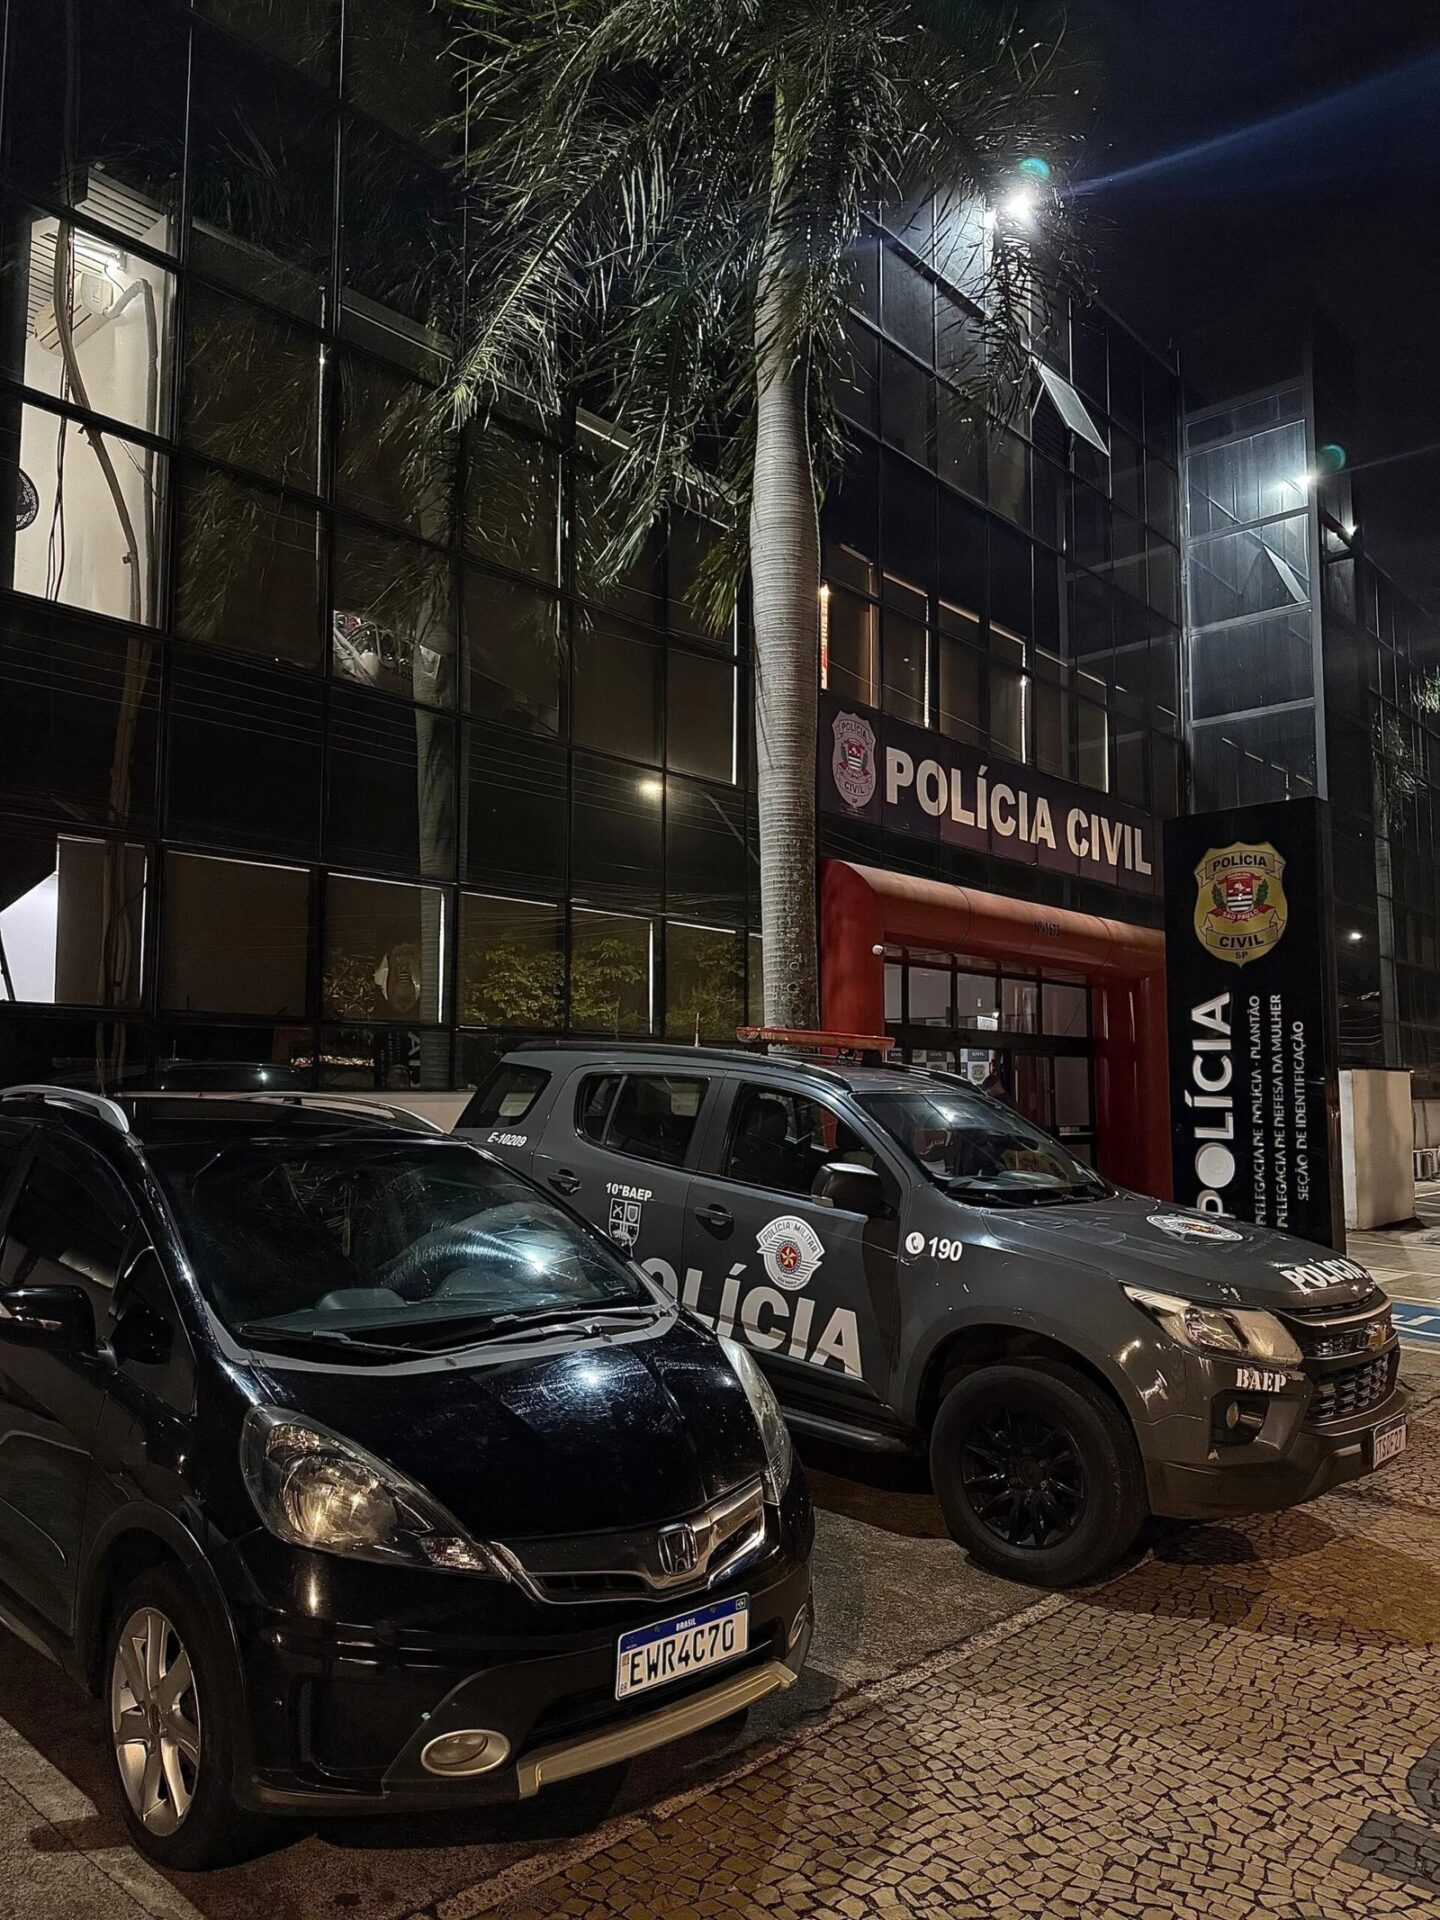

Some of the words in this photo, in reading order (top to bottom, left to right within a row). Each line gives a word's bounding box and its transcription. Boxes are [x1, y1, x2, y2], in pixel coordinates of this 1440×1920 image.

[842, 722, 867, 738] POLÍCIA
[844, 781, 865, 794] CIVIL
[886, 746, 1056, 849] POLÍCIA
[1066, 807, 1152, 875] CIVIL
[1213, 853, 1267, 872] POLÍCIA
[1220, 934, 1264, 948] CIVIL
[1235, 951, 1248, 959] SP
[1247, 995, 1261, 1059] PLANTÃO
[1270, 994, 1282, 1051] MULHER
[1271, 1053, 1283, 1073] DA
[1291, 1021, 1306, 1128] IDENTIFICAÇÃO
[1184, 992, 1235, 1216] POLÍCIA
[1250, 1069, 1263, 1123] POLÍCIA
[1273, 1076, 1285, 1127] DEFESA
[487, 1132, 527, 1147] E-10209
[1253, 1128, 1264, 1146] DE
[1274, 1129, 1286, 1148] DE
[1296, 1131, 1307, 1149] DE
[1253, 1149, 1266, 1225] DELEGACIA
[1275, 1150, 1288, 1228] DELEGACIA
[1295, 1154, 1310, 1200] SEÇÃO
[763, 1221, 791, 1243] POLÍCIA
[794, 1223, 818, 1253] MILITAR
[928, 1236, 963, 1262] 190
[1279, 1258, 1369, 1295] POLÍCIA
[1235, 1368, 1287, 1392] BAEP
[676, 1617, 697, 1631] BRASIL
[630, 1619, 734, 1687] EWR4C70
